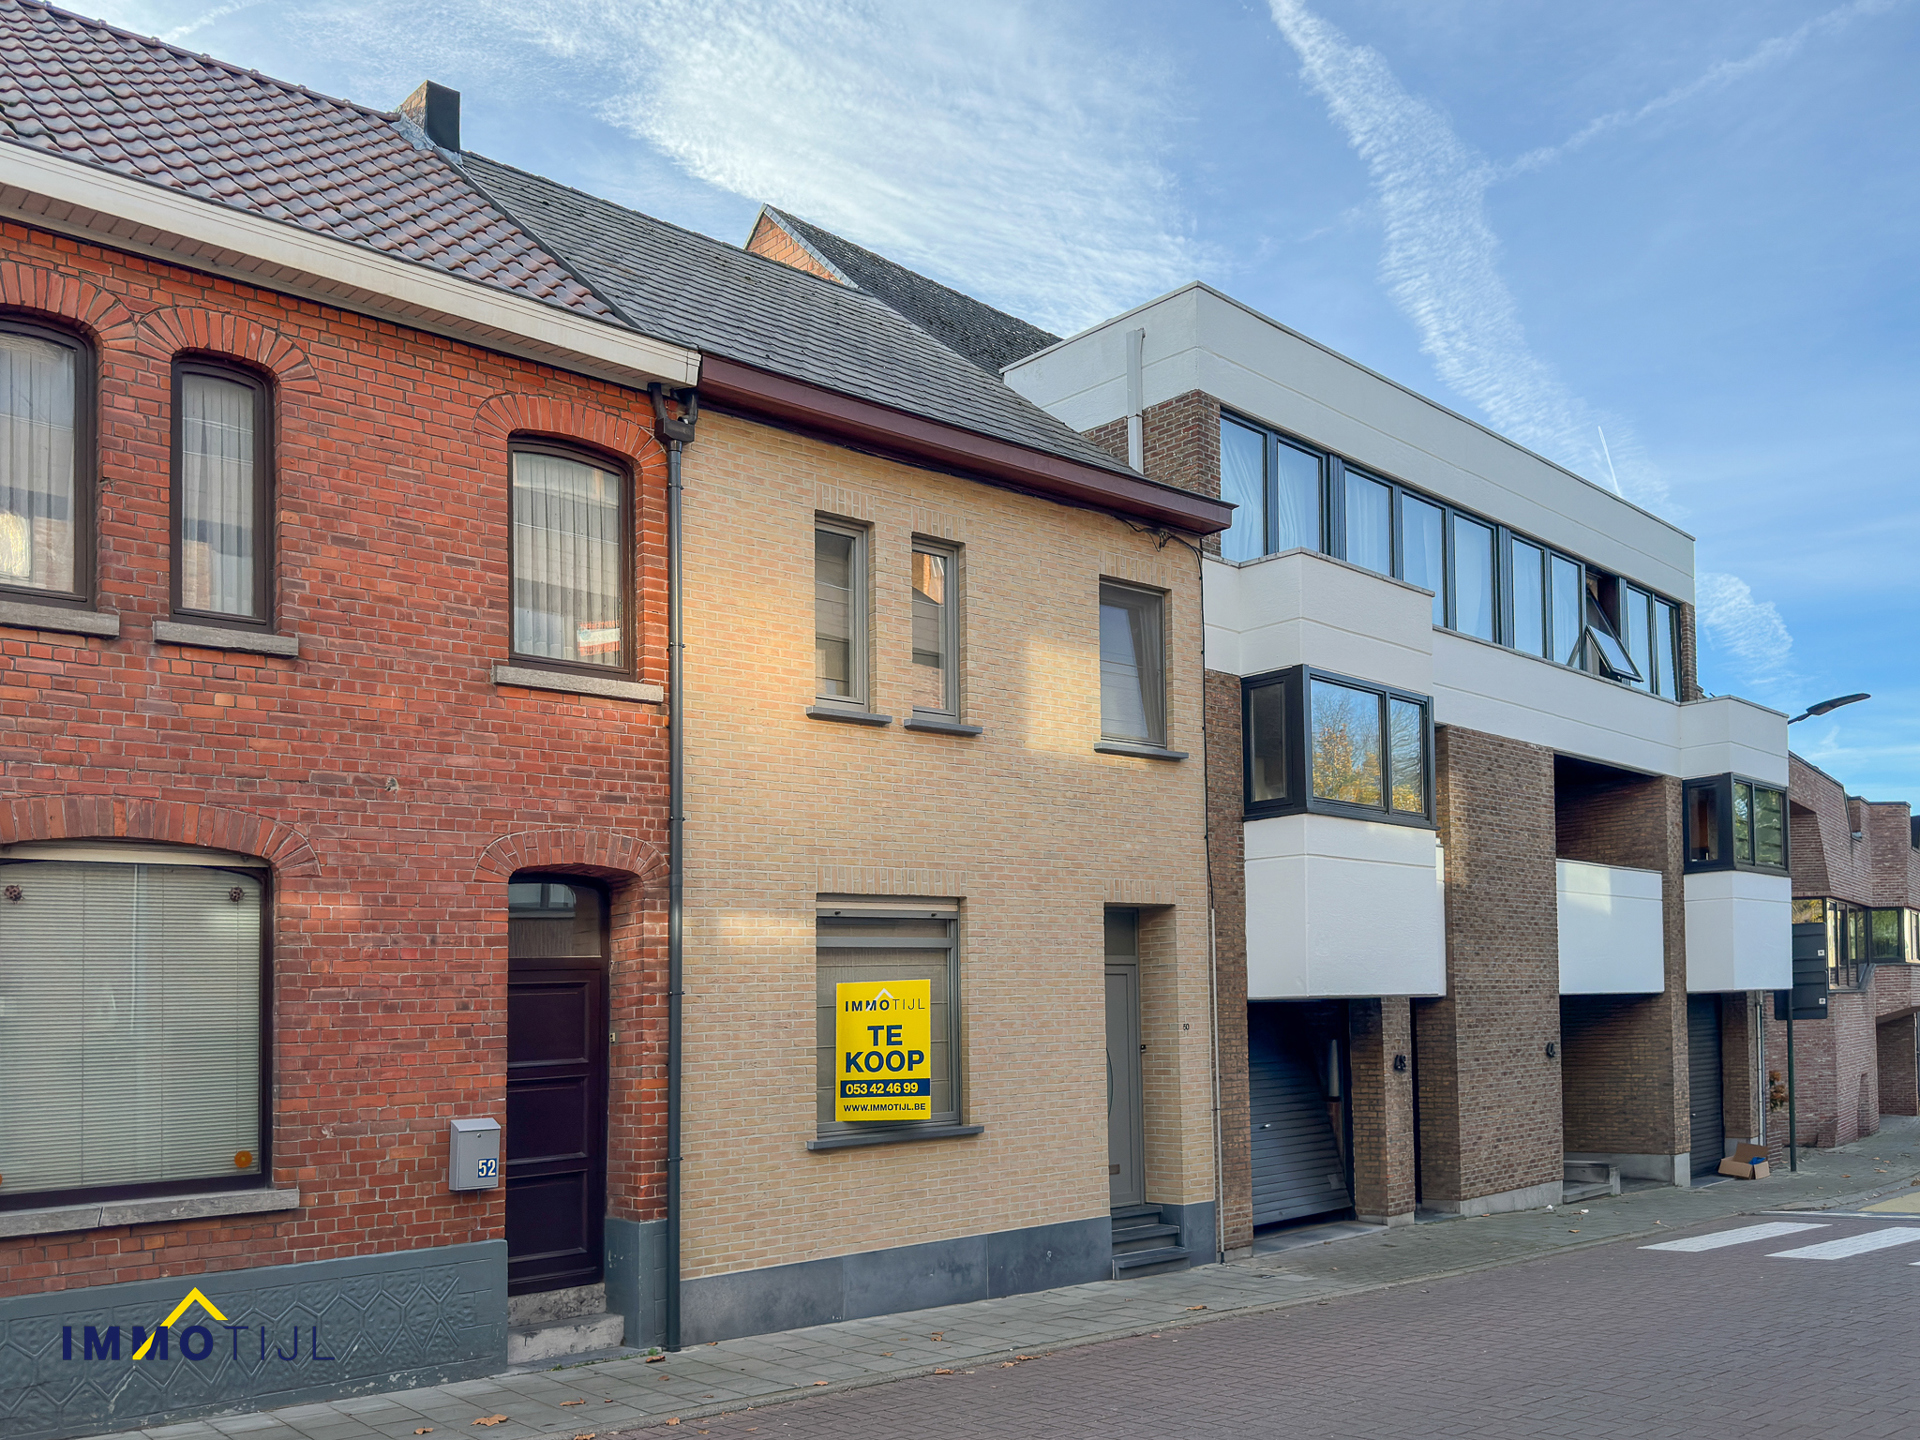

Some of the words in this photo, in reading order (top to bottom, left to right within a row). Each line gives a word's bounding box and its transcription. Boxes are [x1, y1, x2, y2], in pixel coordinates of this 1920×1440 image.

[845, 998, 926, 1012] IMMOTIJL
[867, 1025, 903, 1046] TE
[845, 1050, 925, 1073] KOOP
[845, 1083, 868, 1095] 053
[869, 1083, 885, 1094] 42
[886, 1082, 902, 1094] 46
[903, 1082, 919, 1094] 99
[843, 1103, 926, 1112] WWW.IMMOTIJL.BE
[478, 1159, 496, 1177] 52
